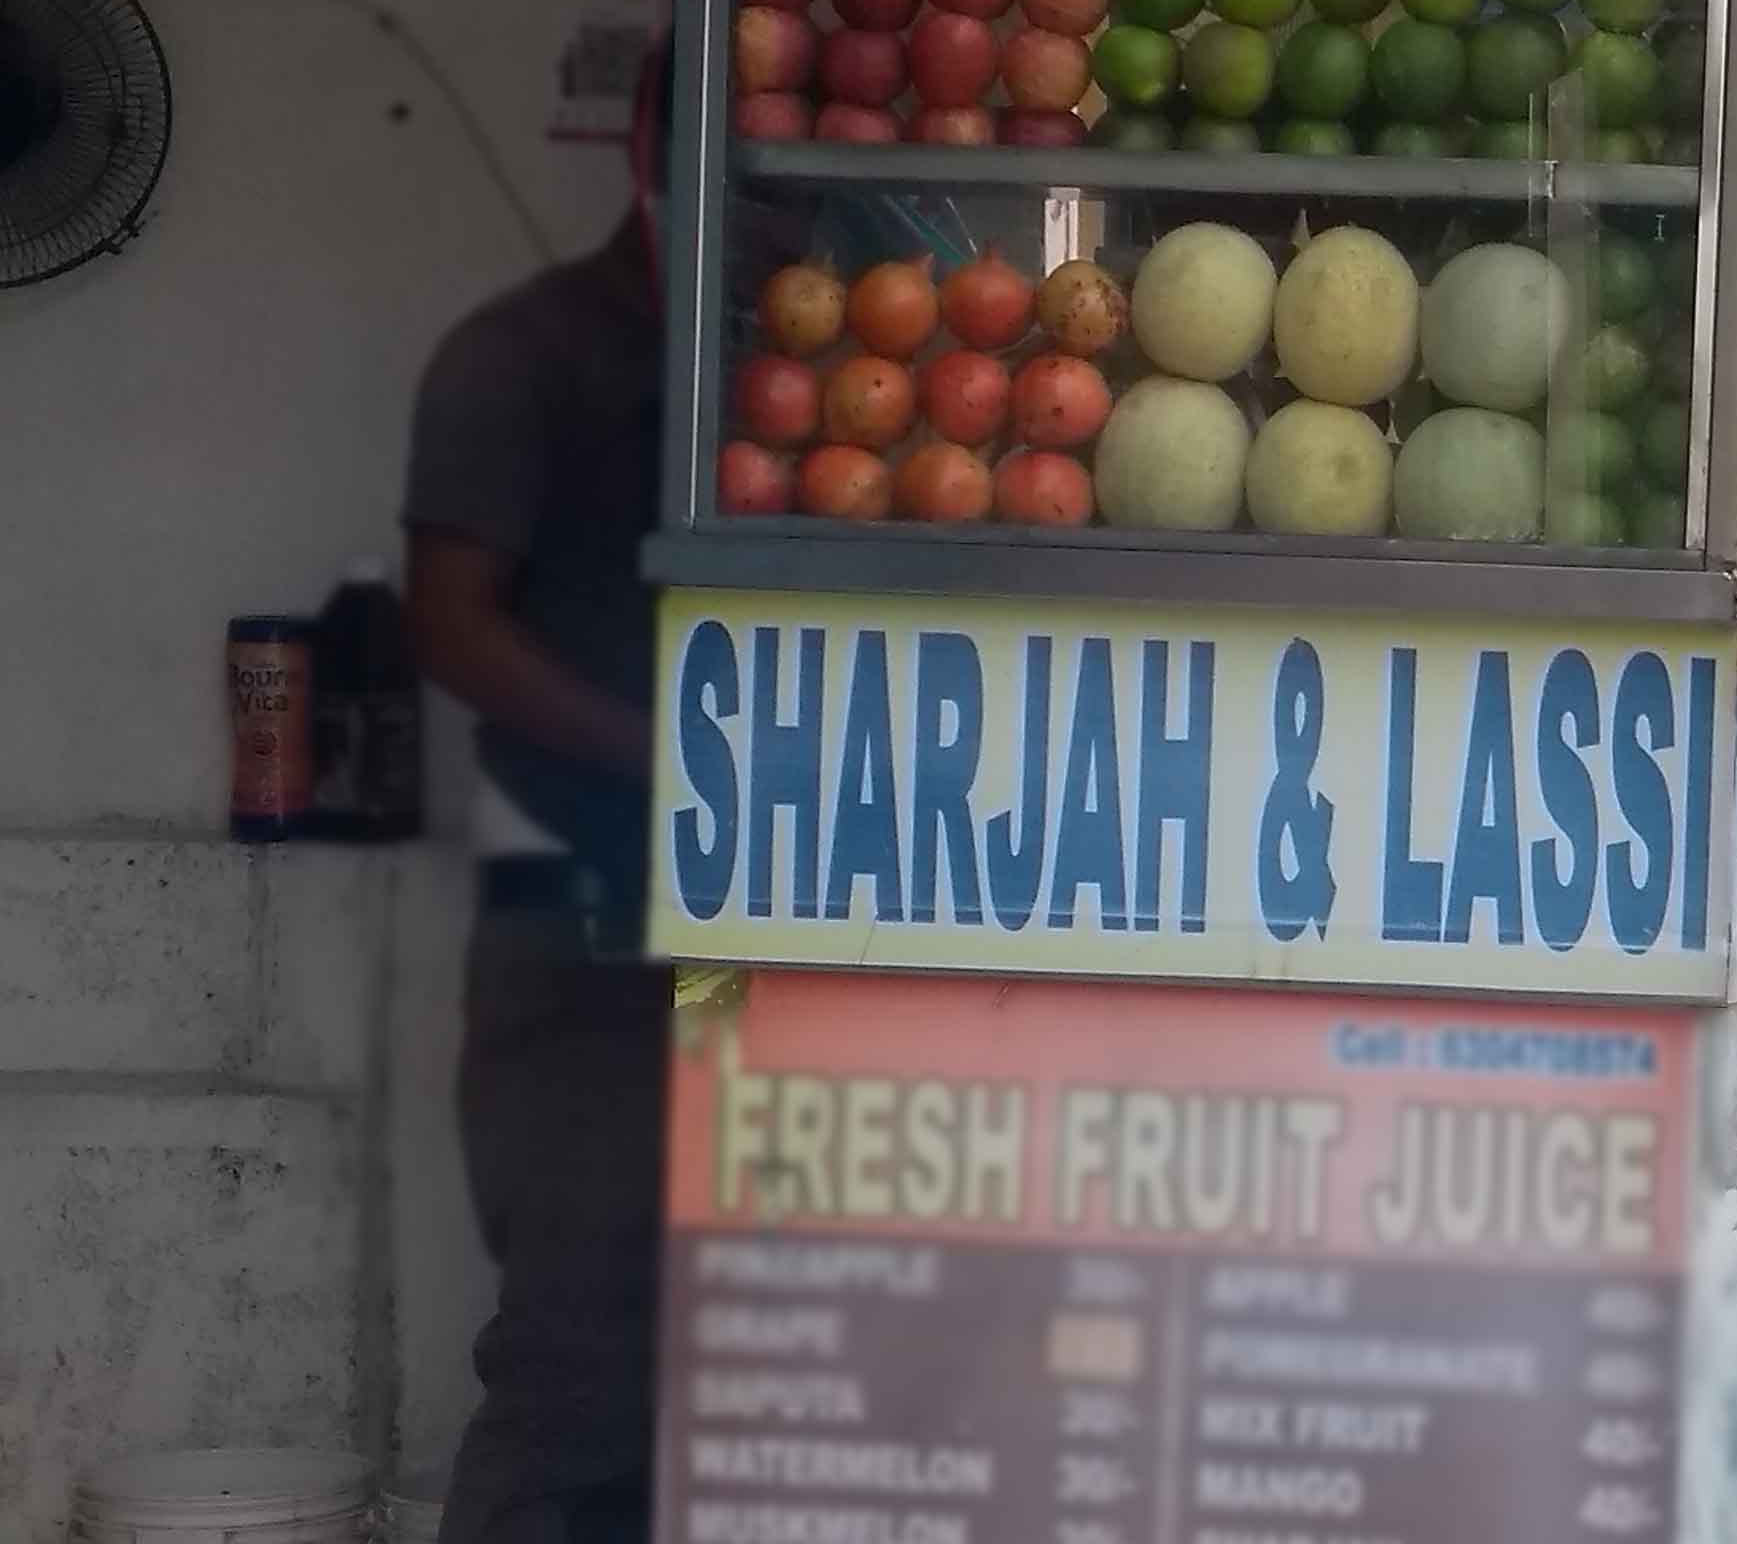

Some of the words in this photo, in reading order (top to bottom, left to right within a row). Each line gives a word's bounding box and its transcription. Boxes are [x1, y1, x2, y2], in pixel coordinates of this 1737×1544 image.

[671, 618, 1215, 934] SHARJAH
[1257, 636, 1337, 942] &
[1380, 647, 1717, 955] LASSI
[714, 1071, 1024, 1224] FRESH
[1053, 1088, 1341, 1236] FRUIT
[1366, 1104, 1659, 1250] JUICE
[1200, 1399, 1281, 1448] MIX
[1294, 1403, 1430, 1453] FRUIT
[689, 1438, 995, 1496] WATERMELON
[1197, 1466, 1364, 1518] MANGO
